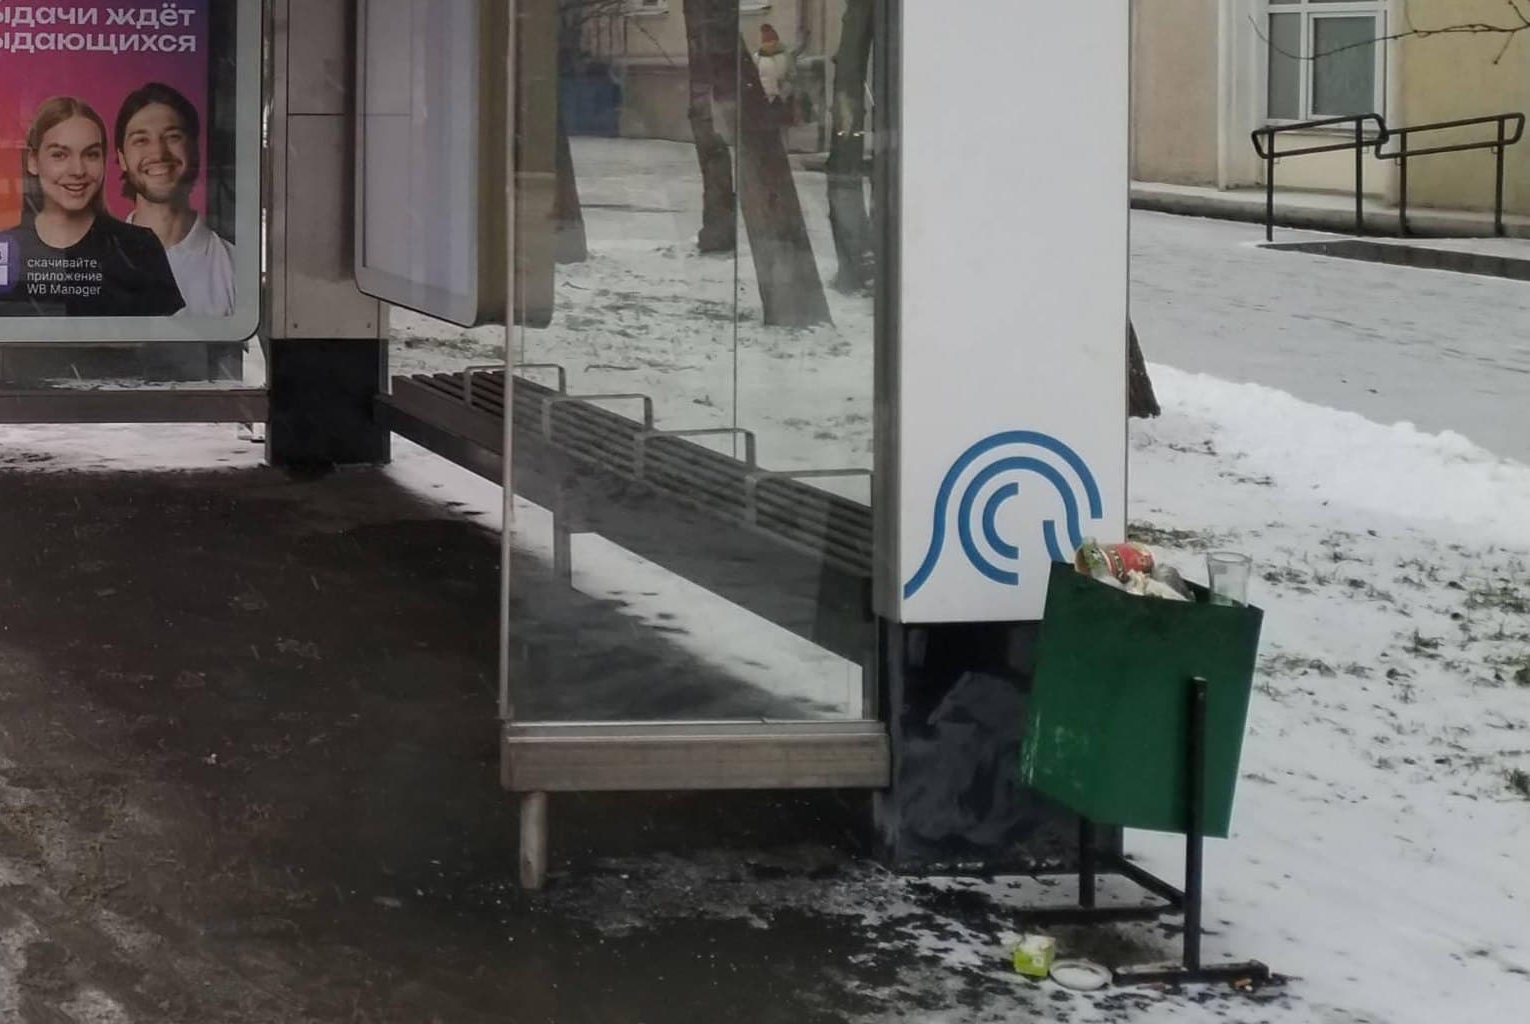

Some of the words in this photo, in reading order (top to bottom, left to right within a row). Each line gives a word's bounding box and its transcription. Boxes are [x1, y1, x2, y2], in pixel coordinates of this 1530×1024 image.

[105, 2, 197, 30] ждёт
[27, 257, 98, 268] скачивайте
[27, 272, 103, 282] приложение
[27, 284, 47, 295] WB
[50, 284, 102, 297] Manager
